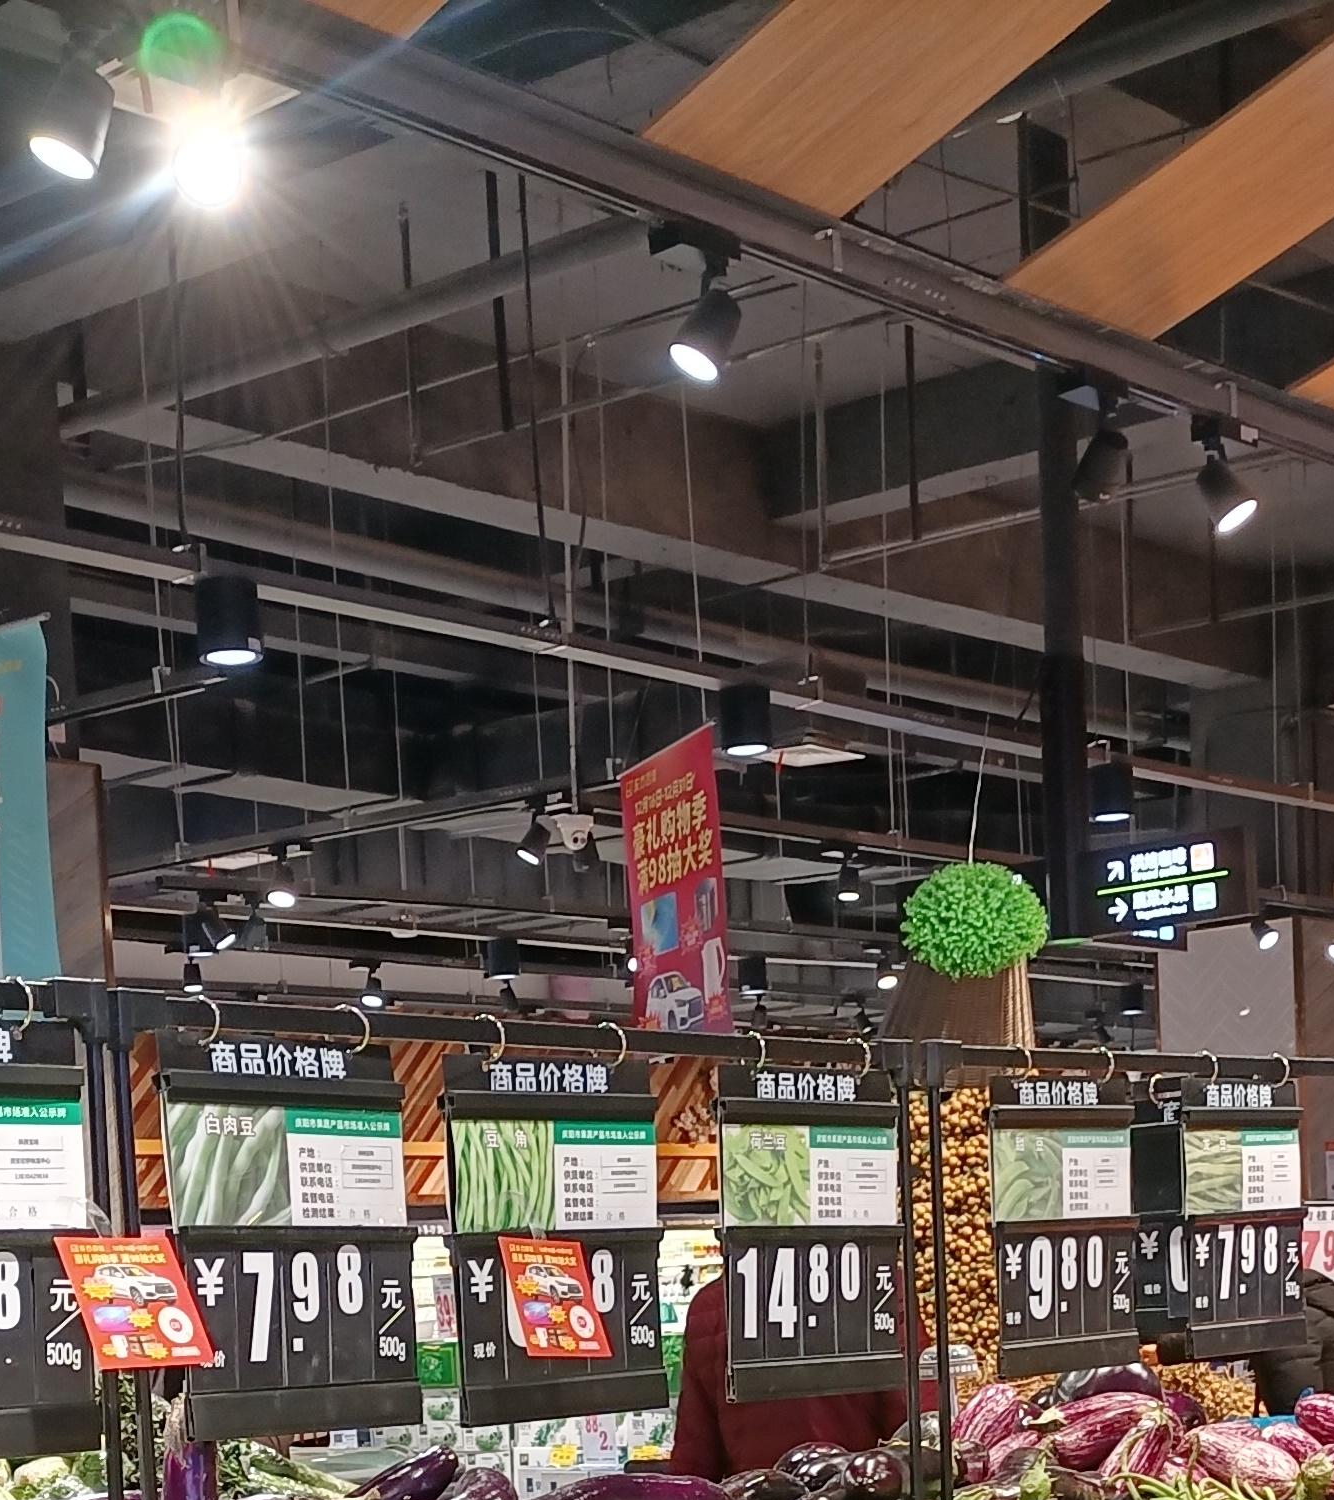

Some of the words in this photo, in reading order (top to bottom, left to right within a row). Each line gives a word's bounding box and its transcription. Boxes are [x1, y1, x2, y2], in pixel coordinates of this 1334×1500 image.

[638, 828, 714, 896] 满98抽大奖
[210, 1041, 346, 1080] 商品价格牌
[490, 1062, 608, 1094] 商品价格牌
[756, 1071, 857, 1102] 商品价格牌
[1018, 1080, 1098, 1106] 商品价格牌
[1206, 1083, 1273, 1107] 商品价格牌
[206, 1114, 255, 1136] 白肉豆
[1029, 1235, 1103, 1320] 9.80
[1218, 1224, 1278, 1300] 7.98
[194, 1258, 224, 1306] ¥
[242, 1245, 362, 1361] 7.98
[736, 1242, 861, 1338] 14.80
[473, 1343, 496, 1359] 现价
